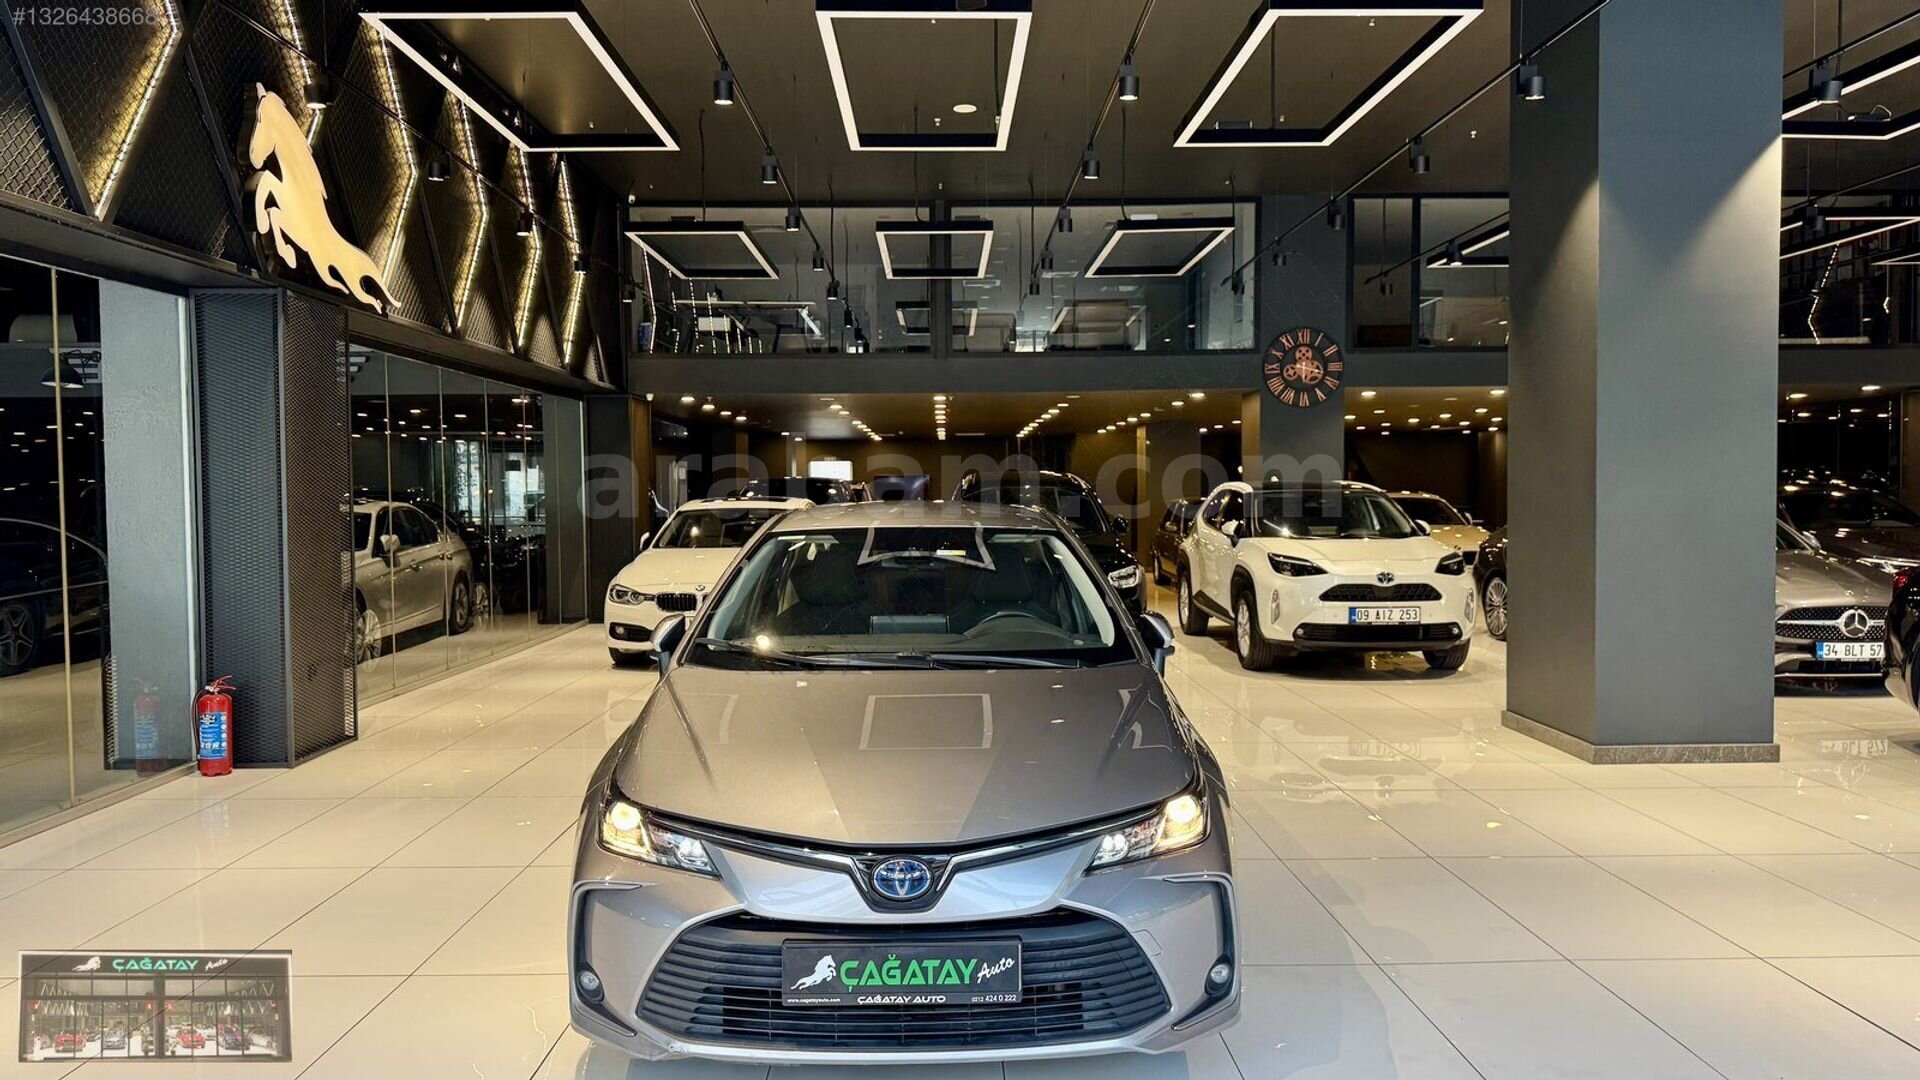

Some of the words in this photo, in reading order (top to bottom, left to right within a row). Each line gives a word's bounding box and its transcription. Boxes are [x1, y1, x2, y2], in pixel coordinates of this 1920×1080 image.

[1357, 610, 1369, 620] 09
[1376, 610, 1393, 620] AIZ
[1399, 609, 1418, 620] 253
[1824, 645, 1838, 656] 34
[1844, 645, 1864, 656] BLT
[840, 954, 978, 992] ÇAĞATAY
[977, 957, 1015, 984] Auto
[857, 994, 911, 1004] ÇAĞATAY
